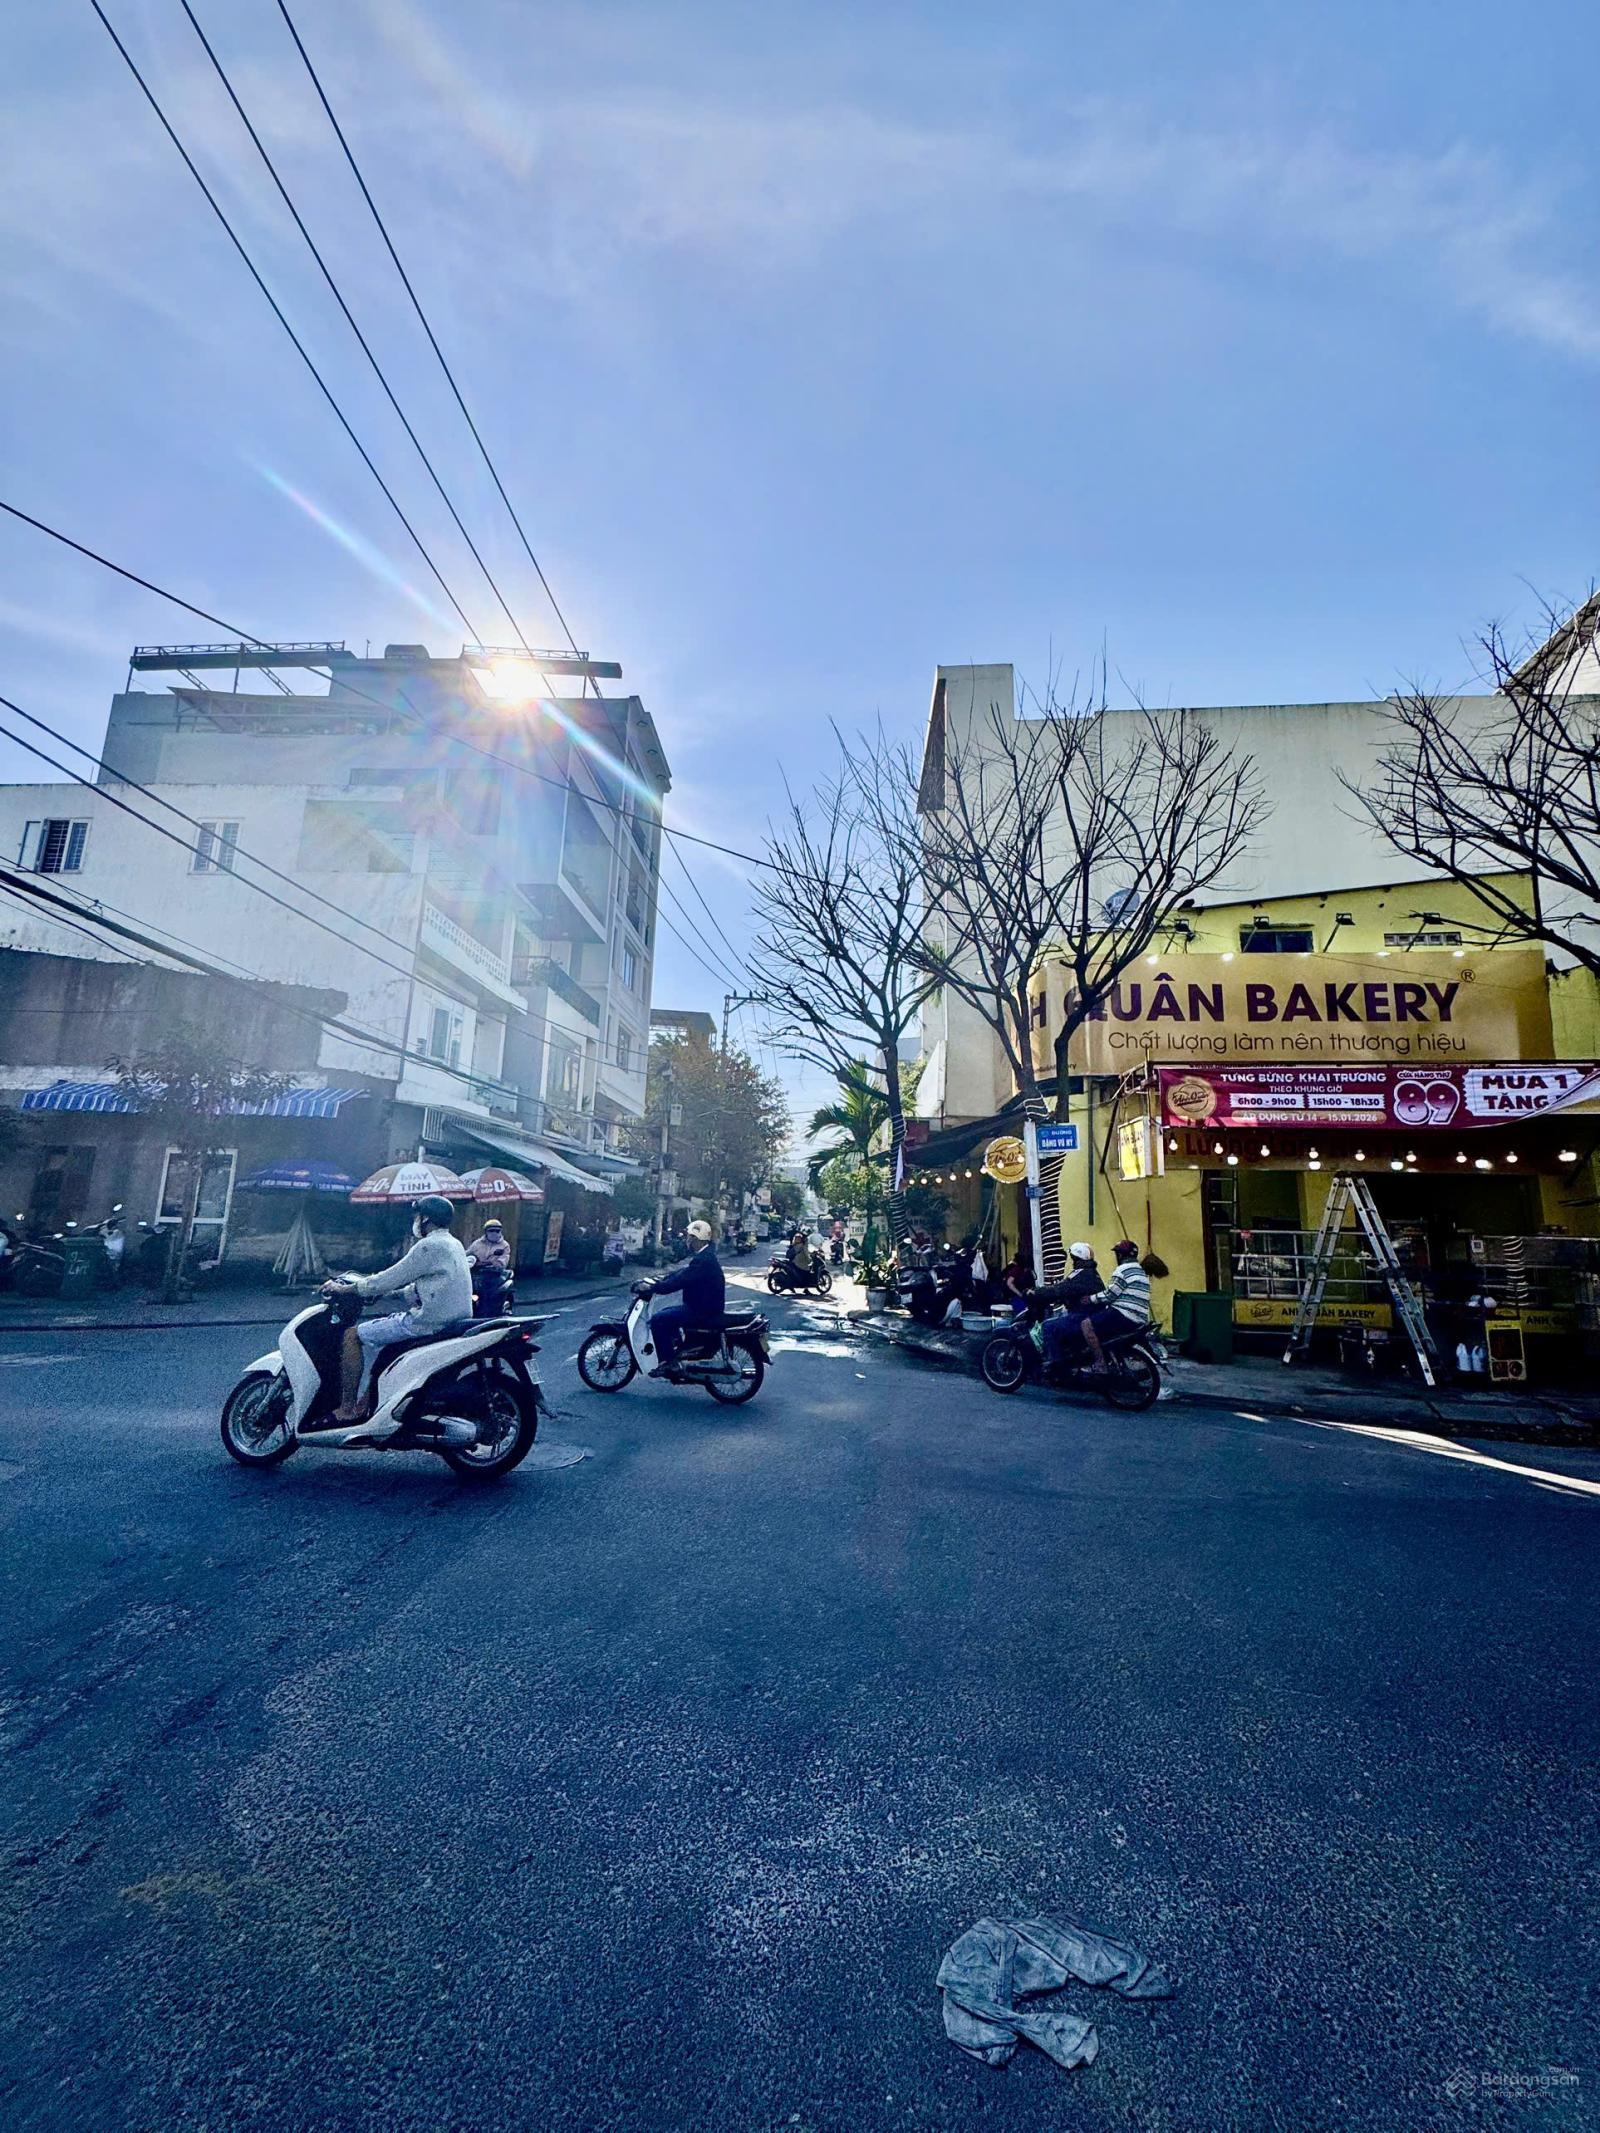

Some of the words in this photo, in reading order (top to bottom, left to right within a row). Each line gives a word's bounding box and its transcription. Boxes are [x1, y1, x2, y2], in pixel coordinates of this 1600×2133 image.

[1245, 983, 1460, 1022] BAKERY
[1108, 1031, 1161, 1050] Chất
[1167, 1033, 1227, 1054] lượng
[1234, 1033, 1274, 1050] làm
[1281, 1033, 1323, 1050] nên
[1329, 1033, 1411, 1055] thương
[1417, 1034, 1466, 1055] hiệu
[1299, 1073, 1331, 1082] KHAI
[1332, 1072, 1387, 1082] TRƯƠNG
[1482, 1074, 1549, 1090] MUA
[1558, 1074, 1568, 1089] 1
[1269, 1085, 1293, 1093] THEO
[1294, 1085, 1326, 1093] KHUNG
[1238, 1097, 1263, 1106] 6h00
[1271, 1097, 1297, 1106] 9h00
[1312, 1098, 1342, 1106] 15h00
[1350, 1098, 1380, 1106] 18h30
[1394, 1080, 1460, 1125] 89
[1259, 1113, 1289, 1123] DỤNG
[1338, 1309, 1376, 1319] BAKERY
